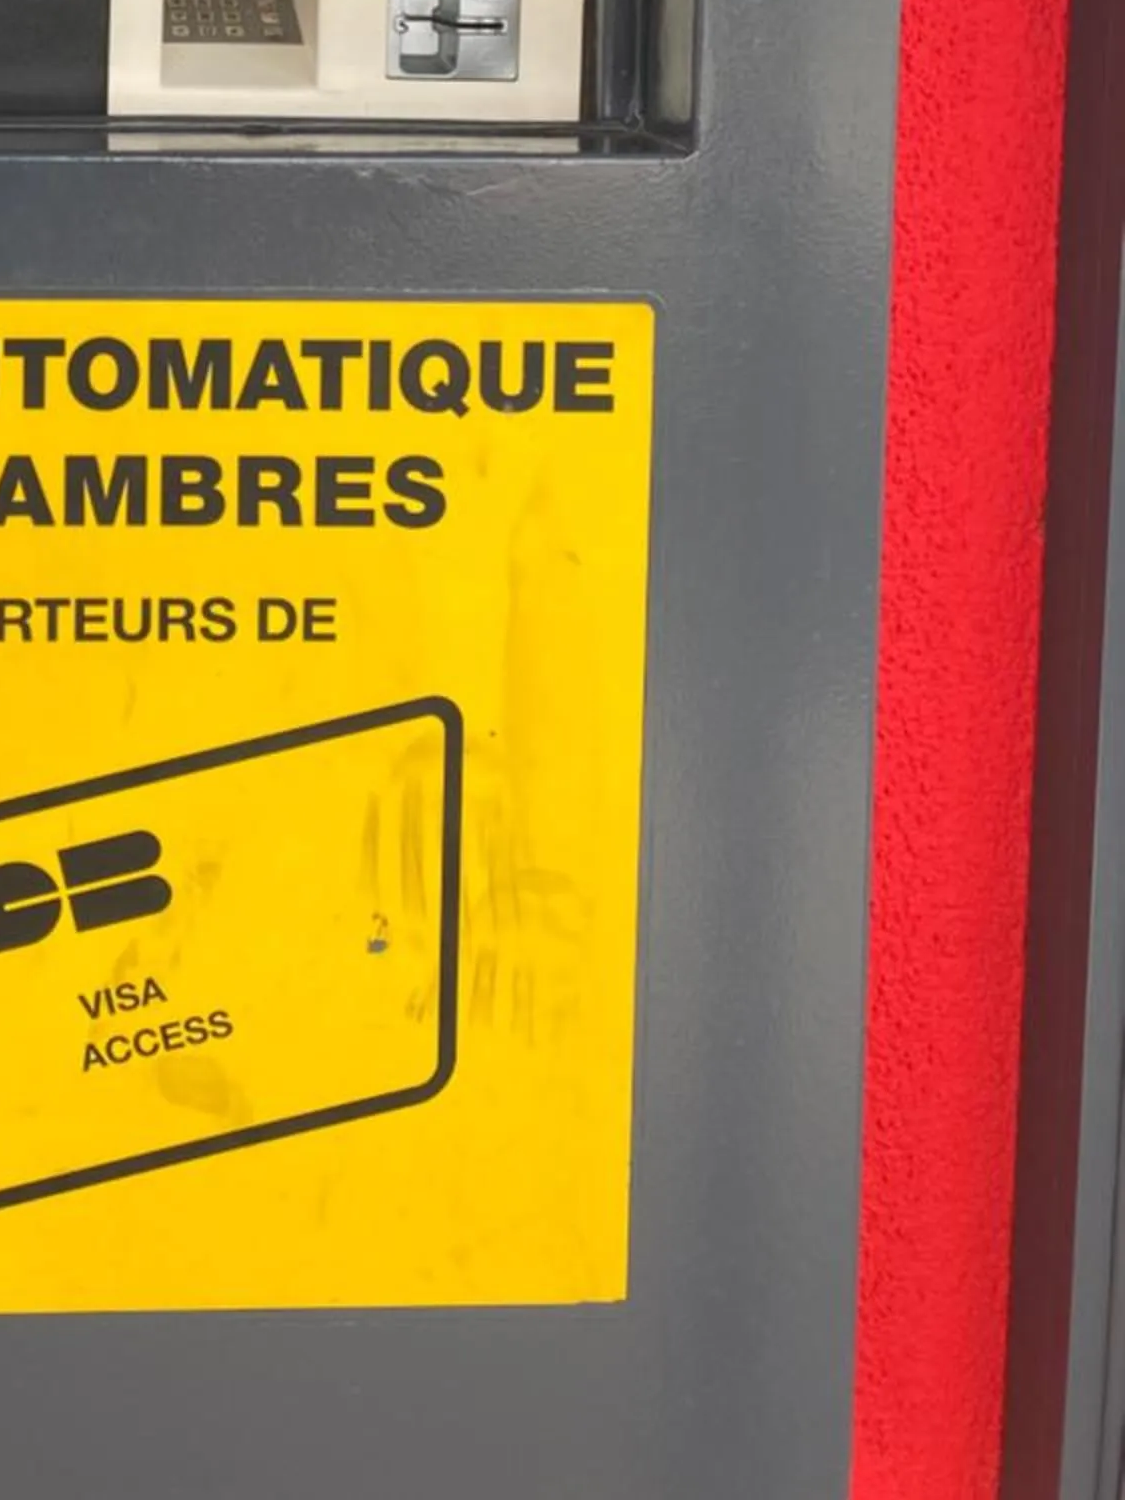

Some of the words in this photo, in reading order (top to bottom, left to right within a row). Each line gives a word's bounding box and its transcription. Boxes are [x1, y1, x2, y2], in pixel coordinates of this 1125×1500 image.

[259, 598, 336, 642] DE
[79, 978, 166, 1019] VISA
[83, 1011, 233, 1071] ACCESS
